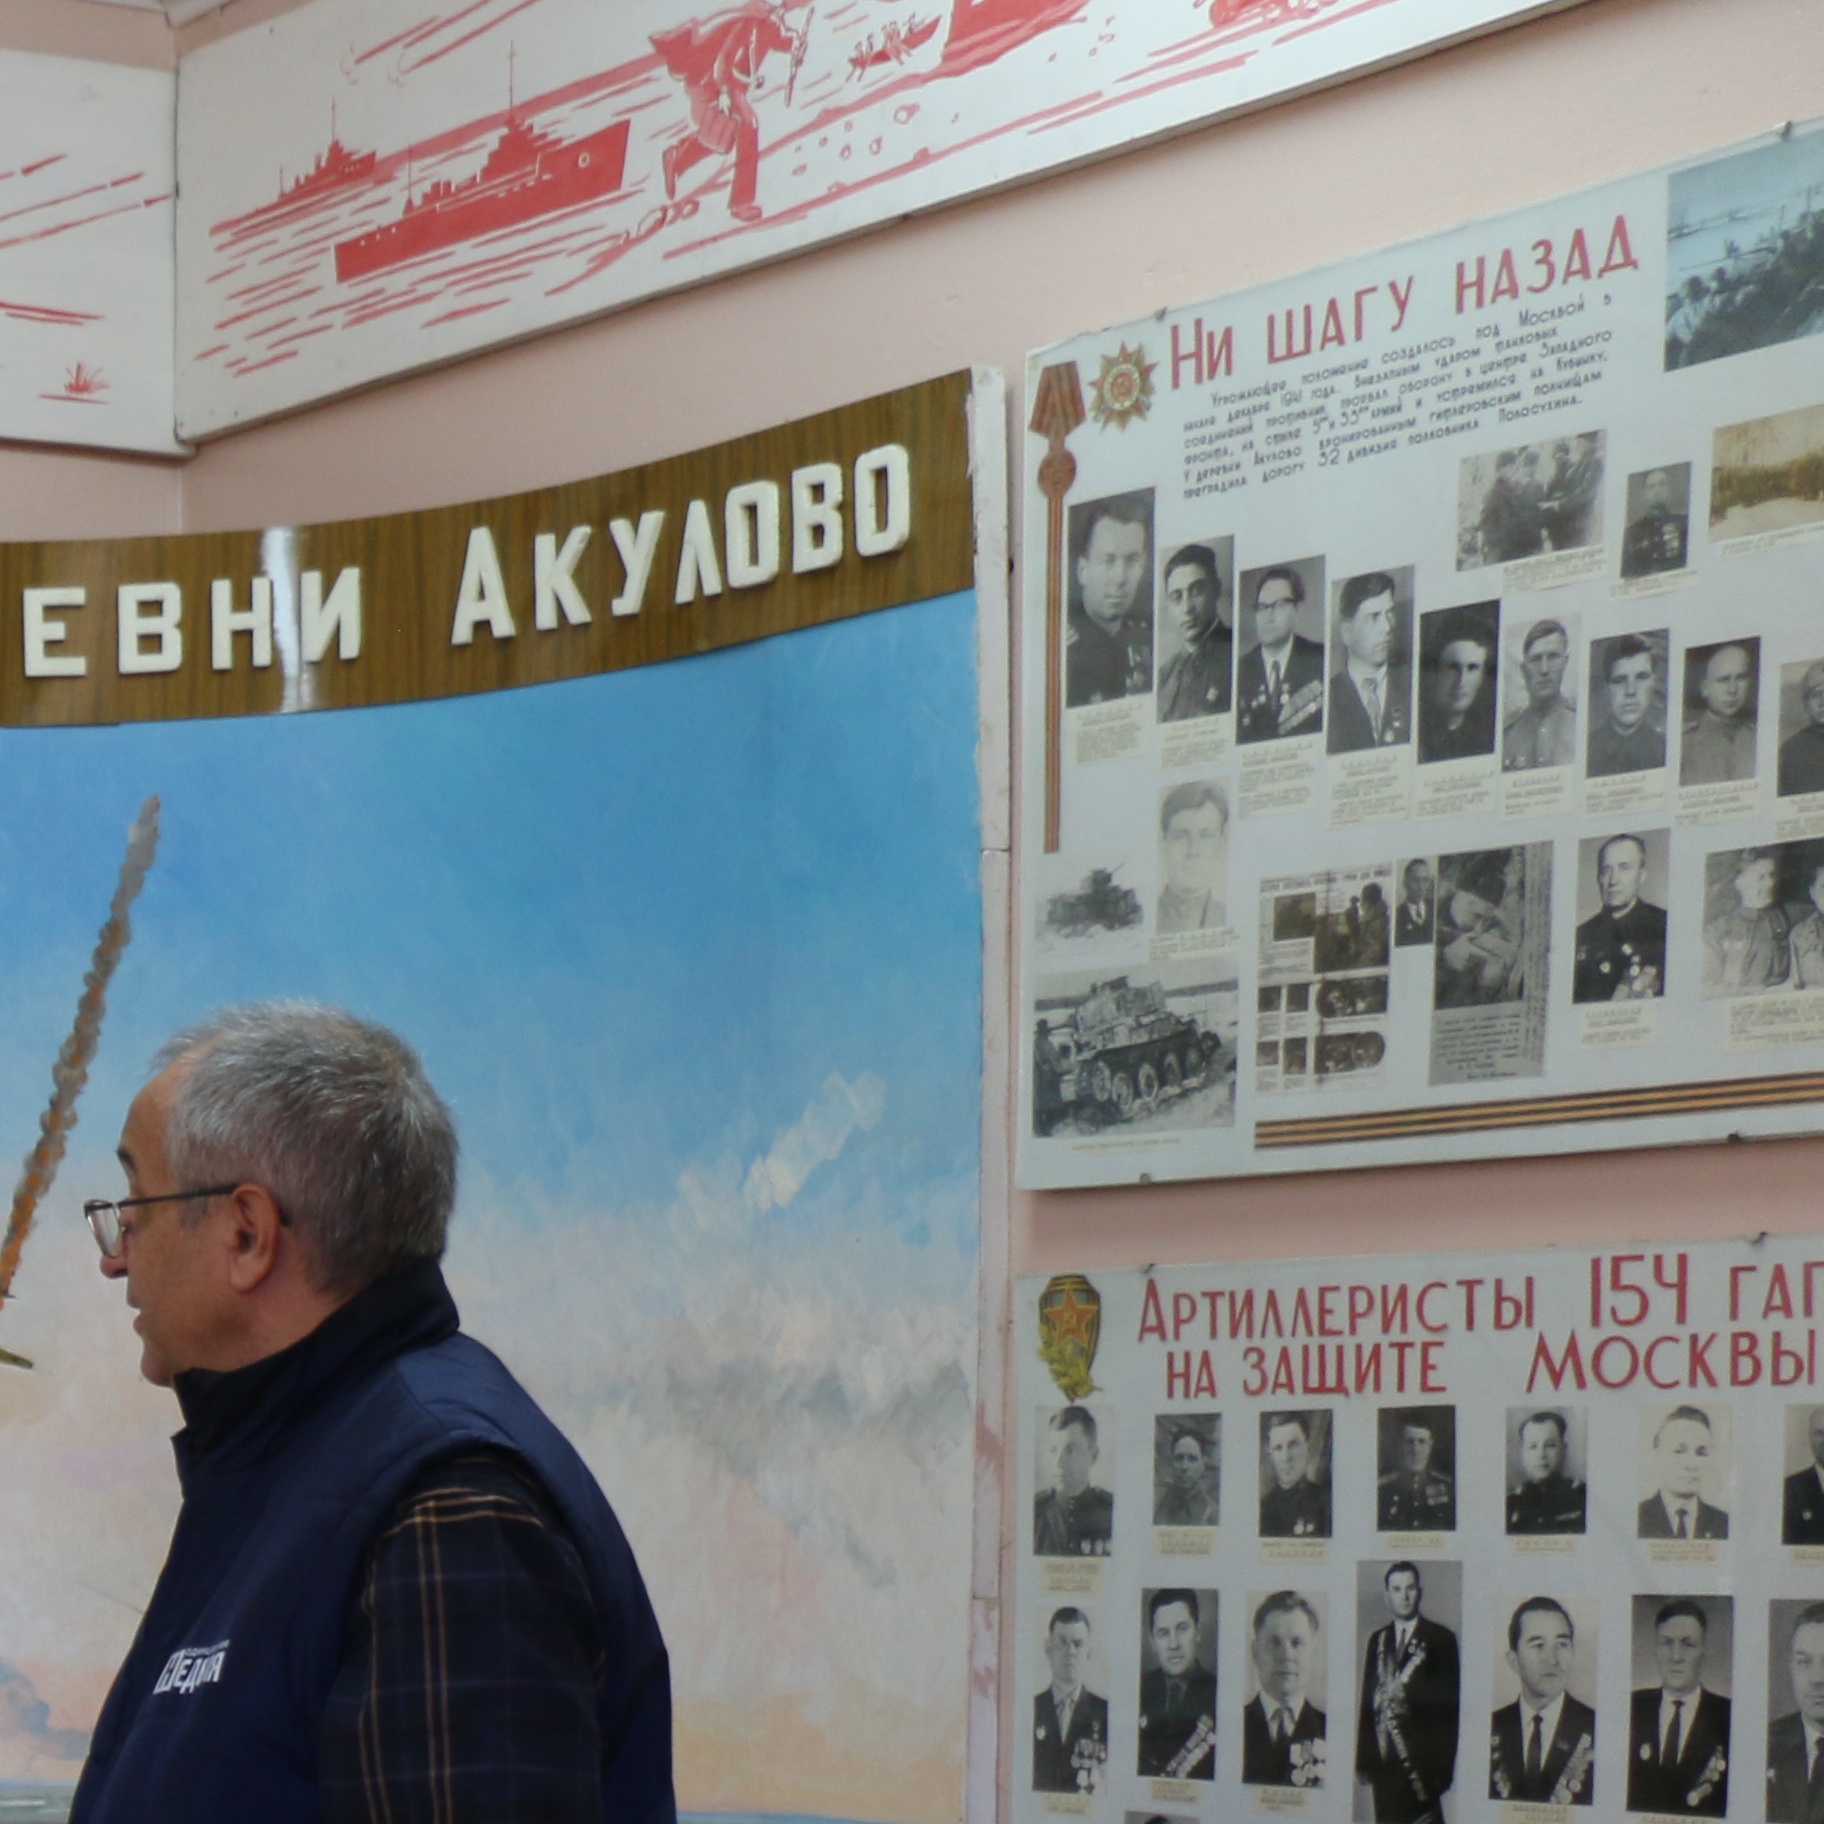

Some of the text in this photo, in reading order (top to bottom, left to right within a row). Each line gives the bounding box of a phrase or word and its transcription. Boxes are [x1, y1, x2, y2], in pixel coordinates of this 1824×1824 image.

[1267, 275, 1413, 365] ШАГУ
[1455, 213, 1639, 316] НАЗАД
[1475, 324, 1500, 339] под
[1519, 292, 1585, 327] Москвой
[451, 444, 912, 647] АКУЛОВО
[1137, 1275, 1535, 1343] АРТИЛЛЕРИСТЫ
[1591, 1253, 1688, 1328] 154
[1166, 1330, 1816, 1400] НА ЗАЩИТЕ МОСКВЫ
